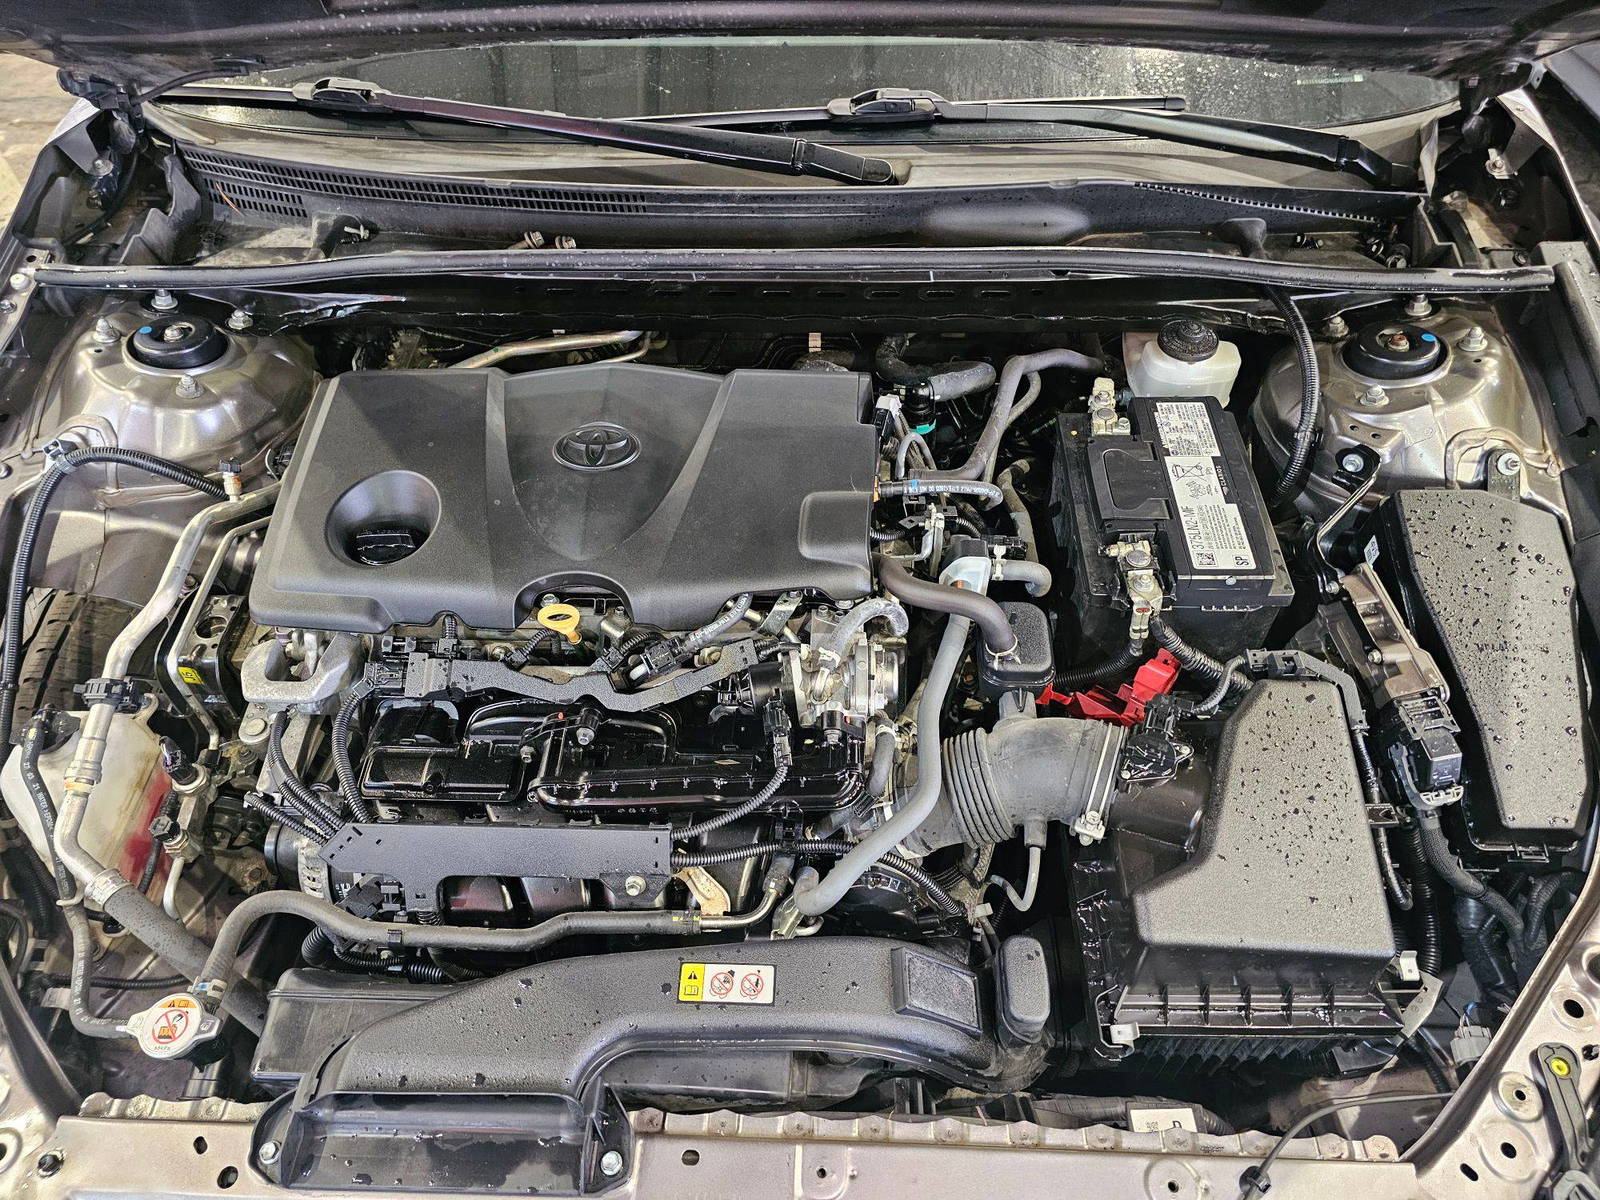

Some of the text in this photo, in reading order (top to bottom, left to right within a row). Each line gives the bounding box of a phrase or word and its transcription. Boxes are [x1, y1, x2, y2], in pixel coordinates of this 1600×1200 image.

[1216, 465, 1226, 487] CLARIOS
[1181, 506, 1205, 550] 375LN2-MF
[1235, 556, 1249, 566] SP
